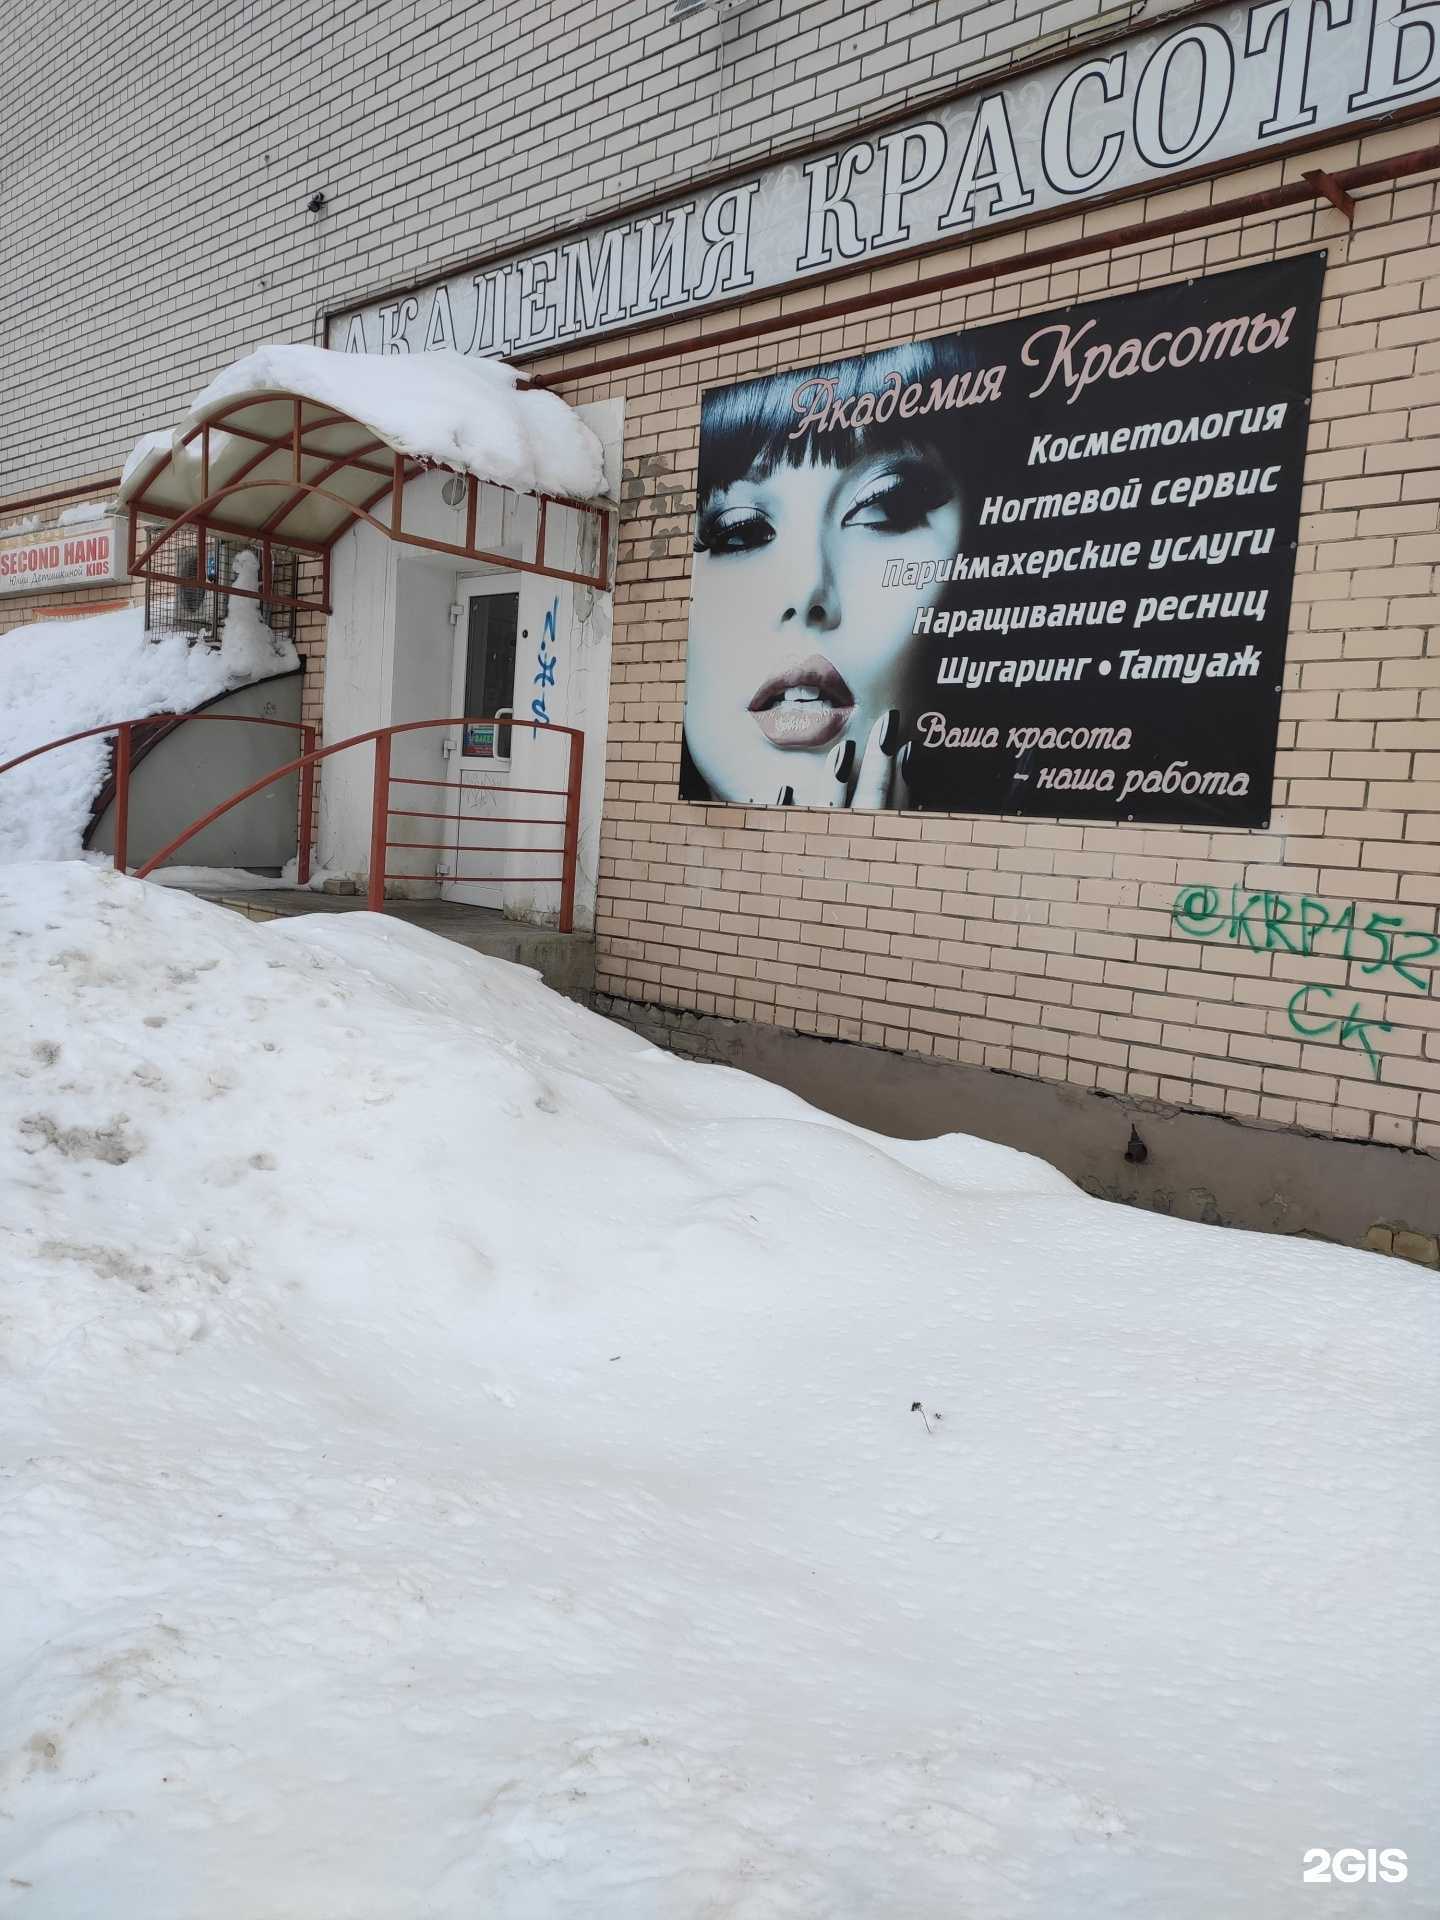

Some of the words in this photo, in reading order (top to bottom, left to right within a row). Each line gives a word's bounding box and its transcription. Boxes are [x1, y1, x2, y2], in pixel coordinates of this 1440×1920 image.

[788, 364, 1008, 440] Академия
[1021, 306, 1297, 405] Красоты
[1027, 402, 1289, 467] Косметология
[979, 478, 1142, 527] Ногтевой
[1150, 464, 1282, 510] сервис
[0, 545, 60, 576] SECOND
[64, 536, 110, 566] HAND
[86, 561, 109, 576] KIDS
[881, 540, 1141, 590] Парикмахерские
[1148, 527, 1276, 570] услуги
[911, 598, 1127, 638] Наращивание
[1133, 589, 1269, 628] ресниц
[936, 655, 1095, 689] Шугаринг
[1118, 644, 1263, 684] Татуаж
[916, 711, 999, 749] Ваша
[1005, 724, 1133, 759] красота
[1036, 765, 1115, 793] наша
[1115, 760, 1251, 802] работа
